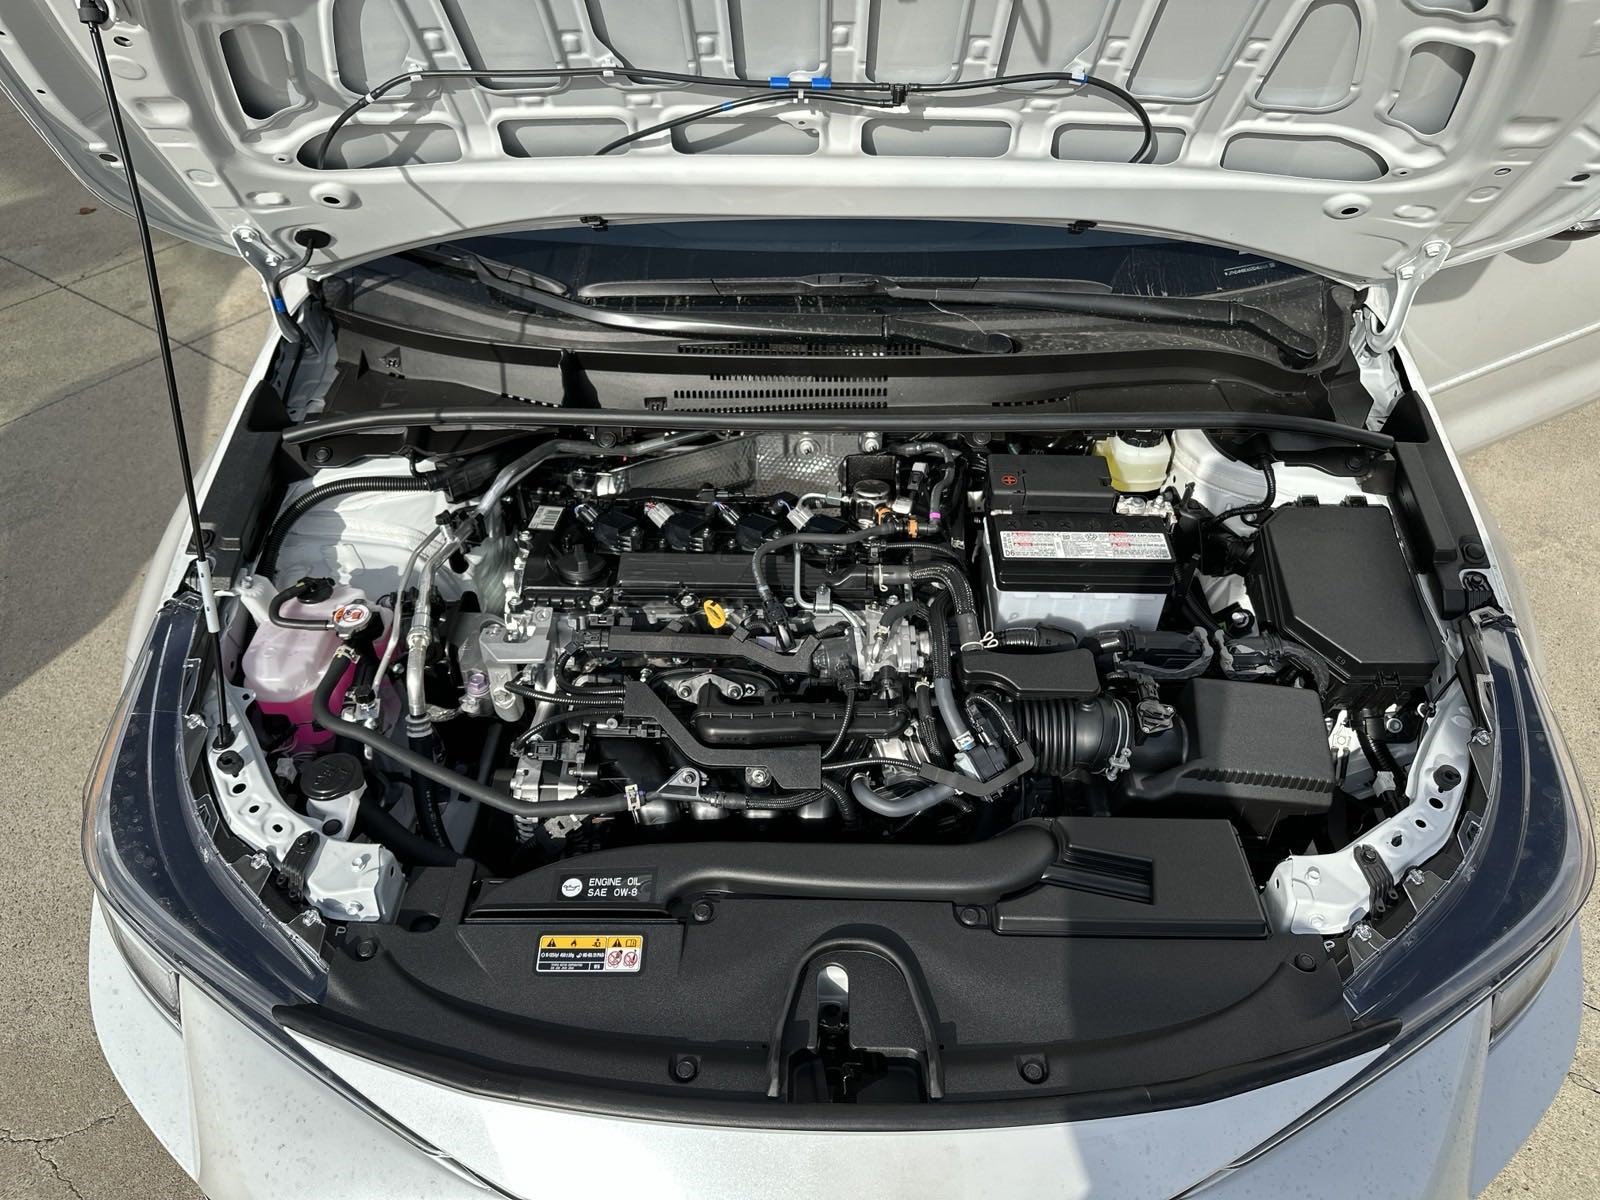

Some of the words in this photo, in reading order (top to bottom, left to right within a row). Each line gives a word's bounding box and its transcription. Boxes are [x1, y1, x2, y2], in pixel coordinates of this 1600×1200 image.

[588, 877, 622, 887] ENGINE
[627, 877, 641, 886] OIL
[587, 888, 607, 897] SAE
[613, 888, 638, 897] 0W-8
[334, 926, 347, 937] P
